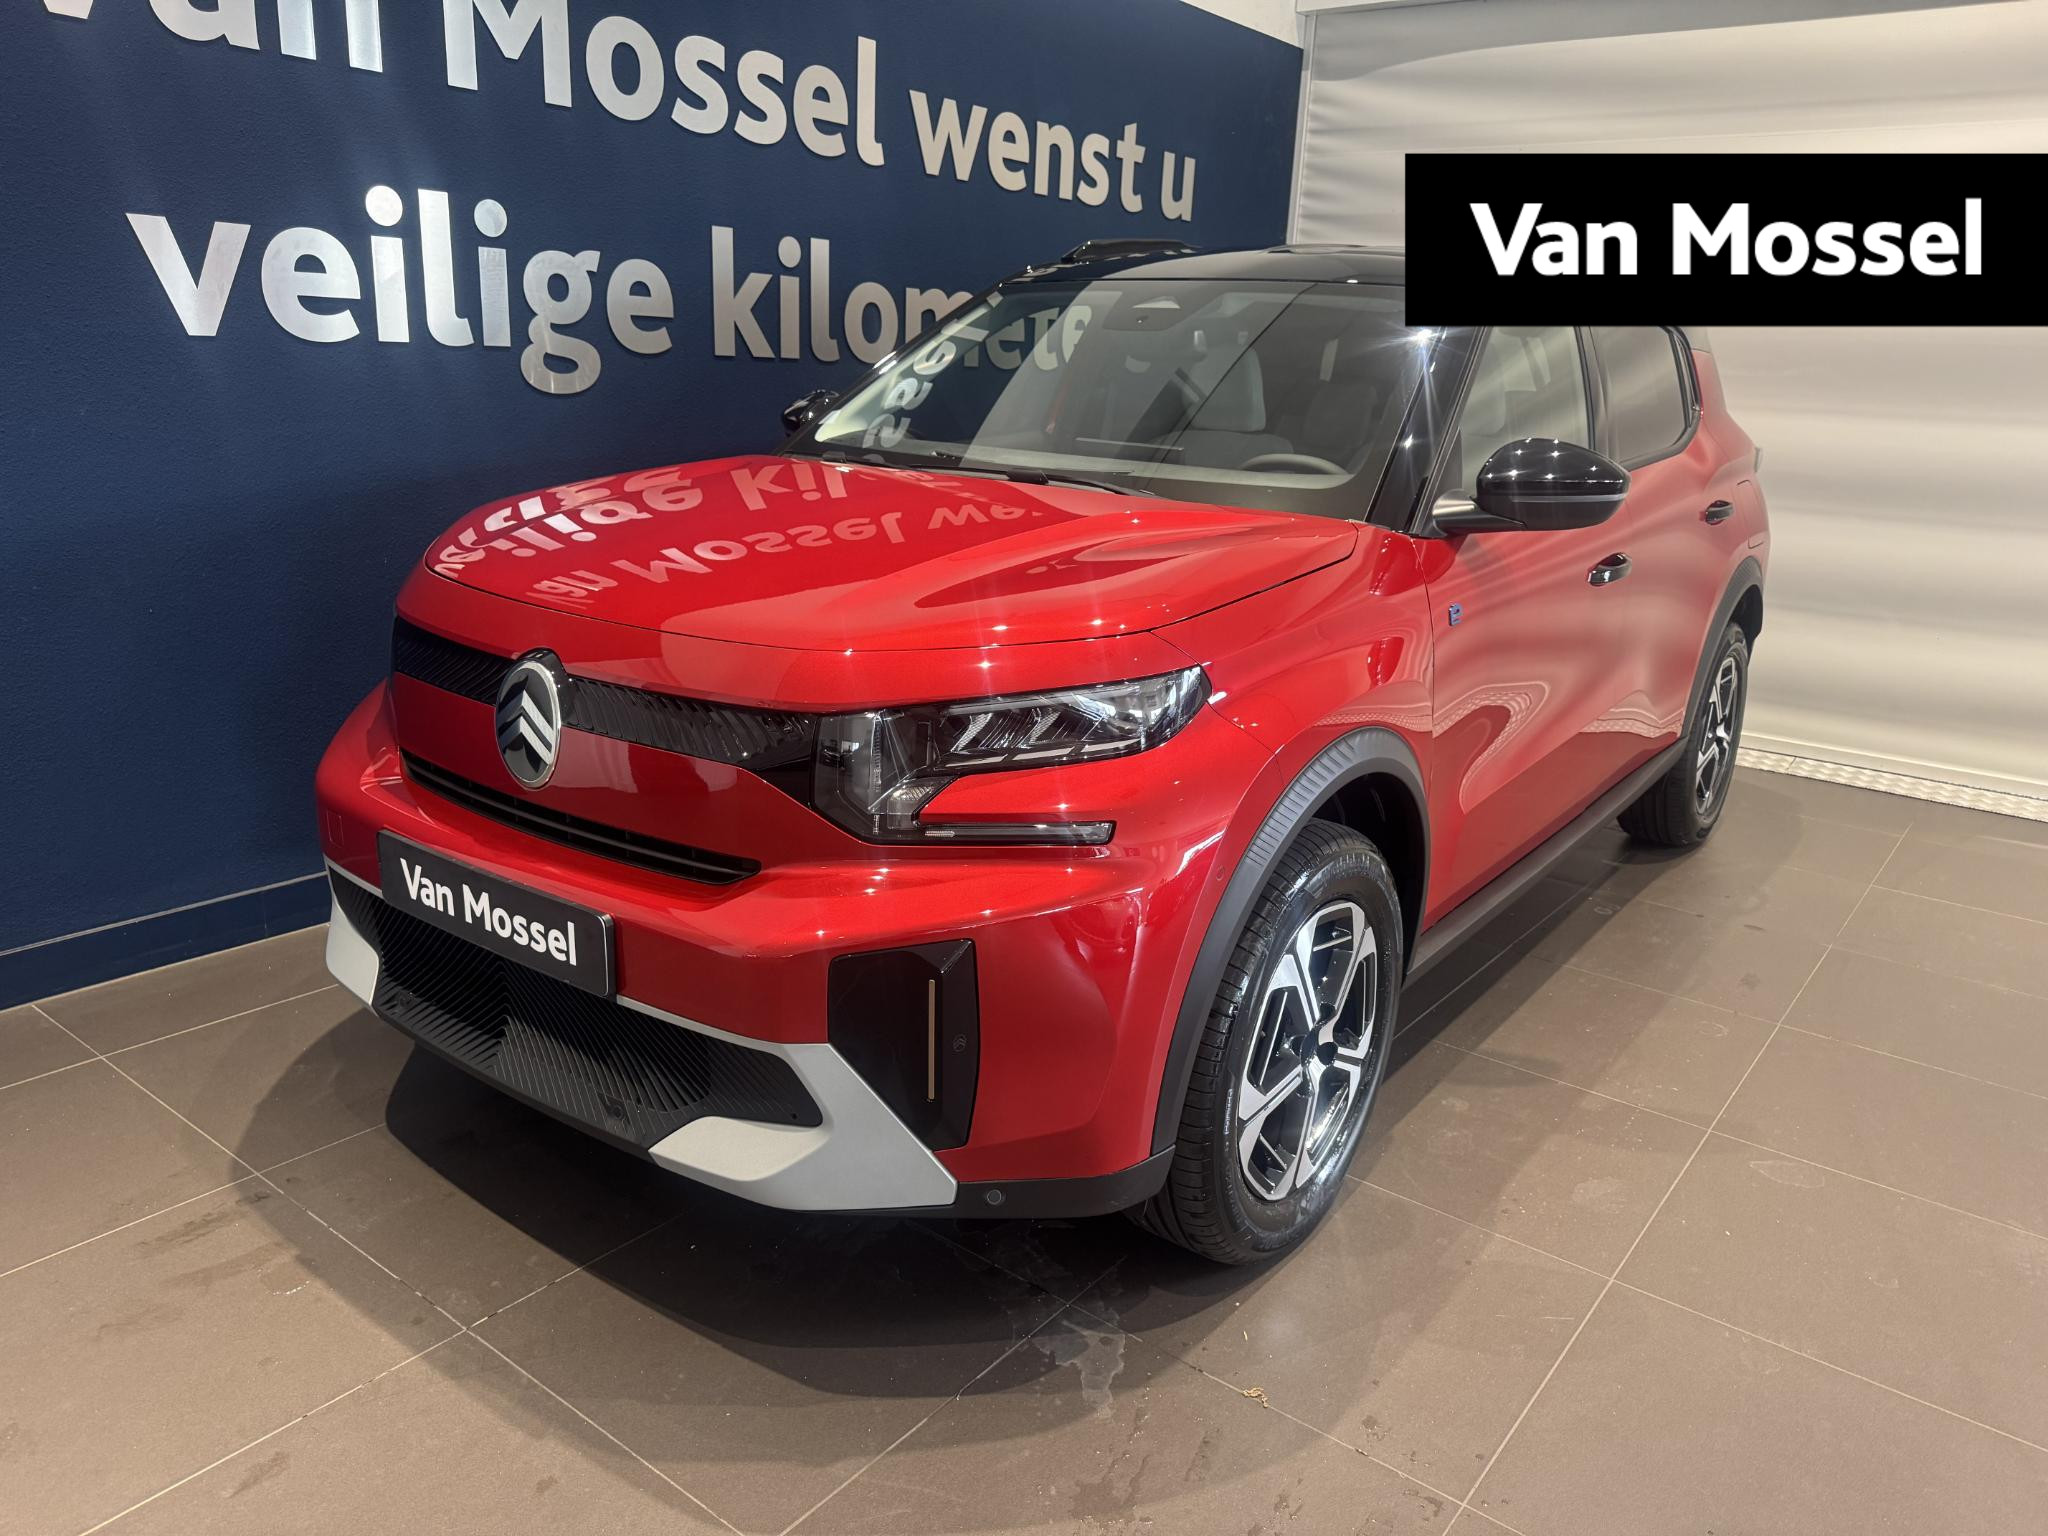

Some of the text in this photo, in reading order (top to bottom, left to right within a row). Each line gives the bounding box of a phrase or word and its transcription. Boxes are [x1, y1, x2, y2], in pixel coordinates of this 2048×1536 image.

[442, 0, 885, 166] Mossel
[909, 89, 1146, 213] wenst
[1161, 151, 1195, 221] u
[126, 185, 674, 394] veilige
[400, 857, 577, 966] Van Mossel
